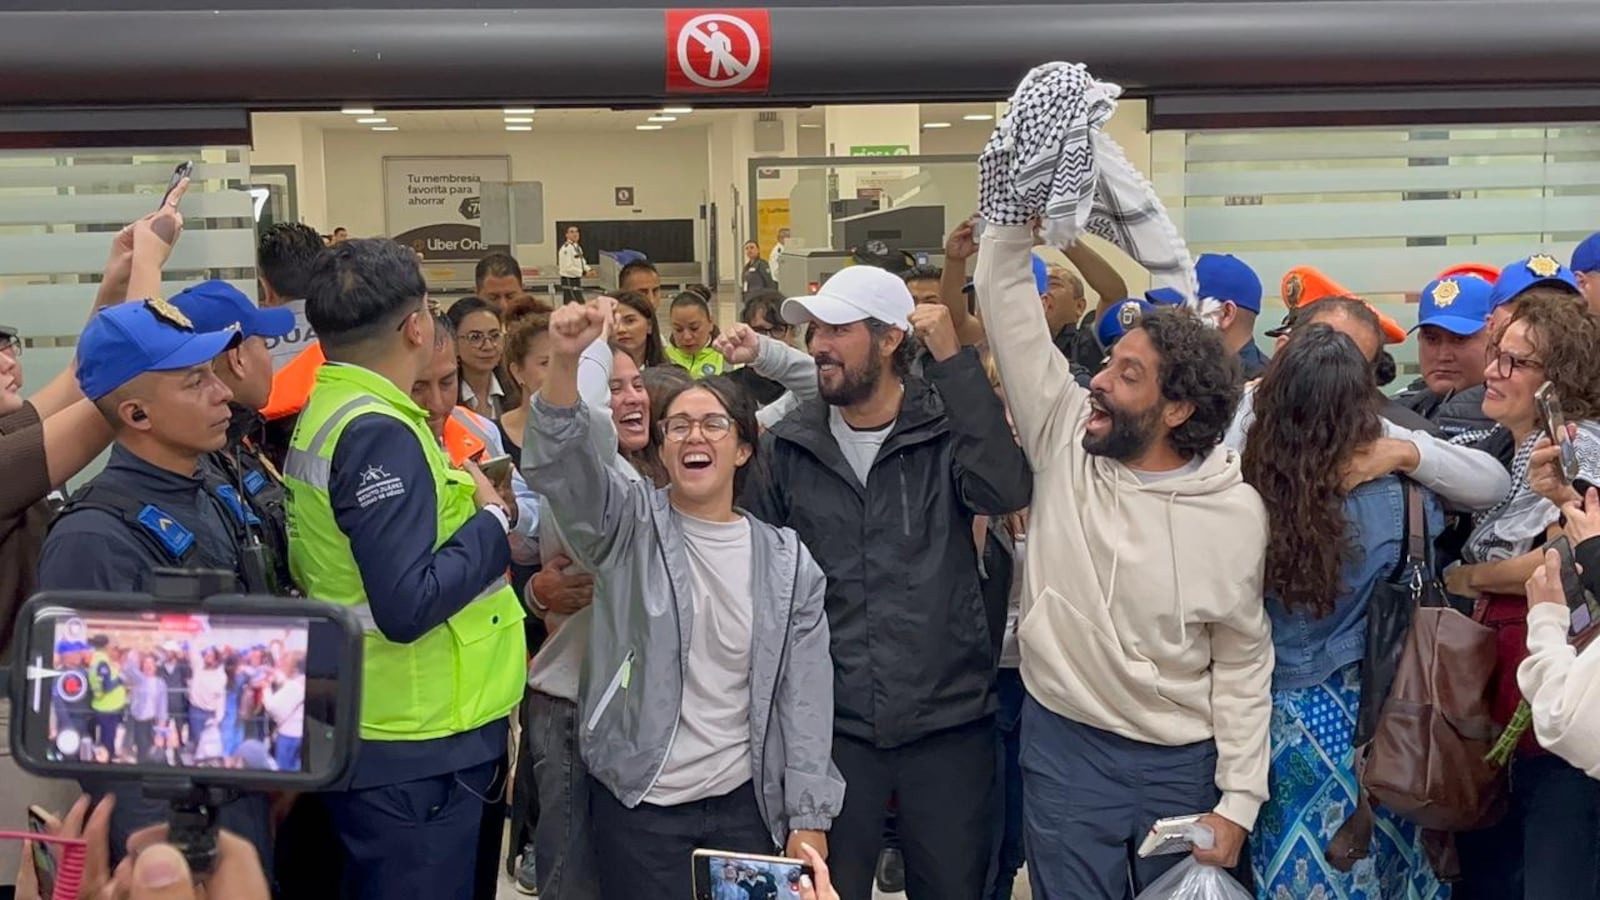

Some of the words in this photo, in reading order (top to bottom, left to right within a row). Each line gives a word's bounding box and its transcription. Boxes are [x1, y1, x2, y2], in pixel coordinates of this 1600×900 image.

[408, 174, 421, 183] Tu
[408, 185, 448, 194] favorita
[450, 187, 473, 196] para
[248, 188, 270, 223] 7
[408, 195, 445, 205] ahorrar
[427, 238, 458, 250] Uber
[460, 238, 488, 250] One
